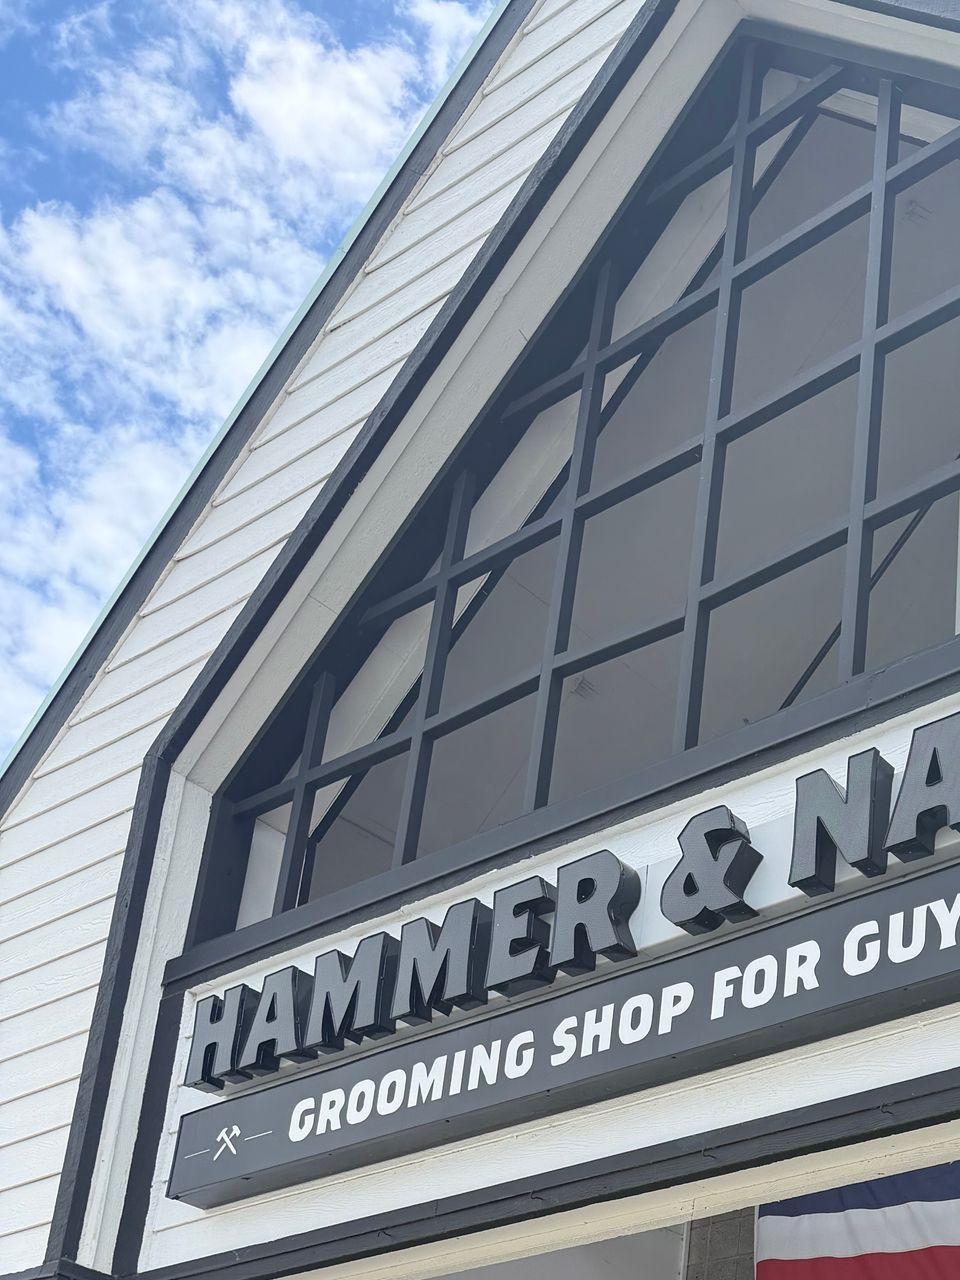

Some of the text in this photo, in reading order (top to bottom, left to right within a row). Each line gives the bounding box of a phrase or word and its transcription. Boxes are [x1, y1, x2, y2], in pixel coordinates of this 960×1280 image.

[183, 849, 640, 1092] HAMMER
[661, 805, 764, 936] &
[288, 1031, 535, 1143] GROOMING
[549, 981, 696, 1067] SHOP
[709, 940, 821, 1021] FOR
